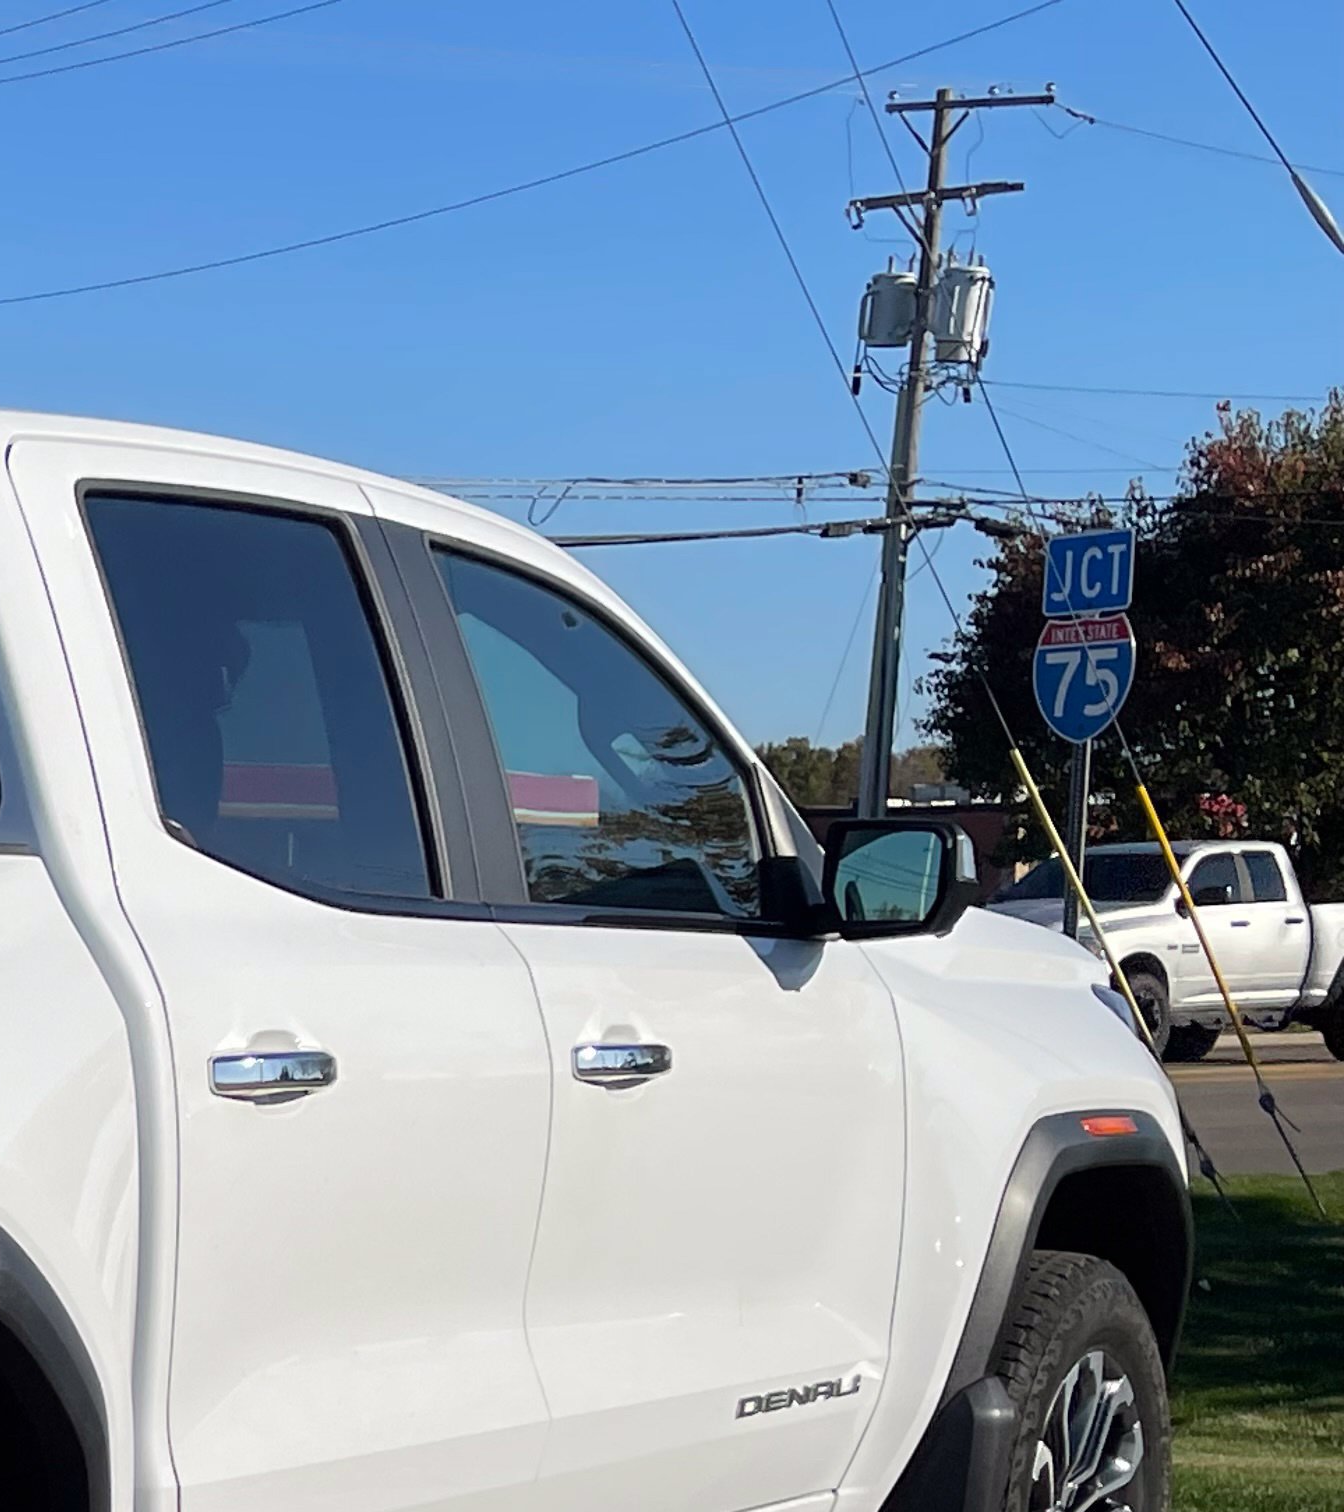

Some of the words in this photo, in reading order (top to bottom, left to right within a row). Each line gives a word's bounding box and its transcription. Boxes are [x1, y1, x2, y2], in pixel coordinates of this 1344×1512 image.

[1050, 543, 1127, 602] JCT
[1045, 647, 1119, 719] 75
[735, 1373, 863, 1420] DENALI
